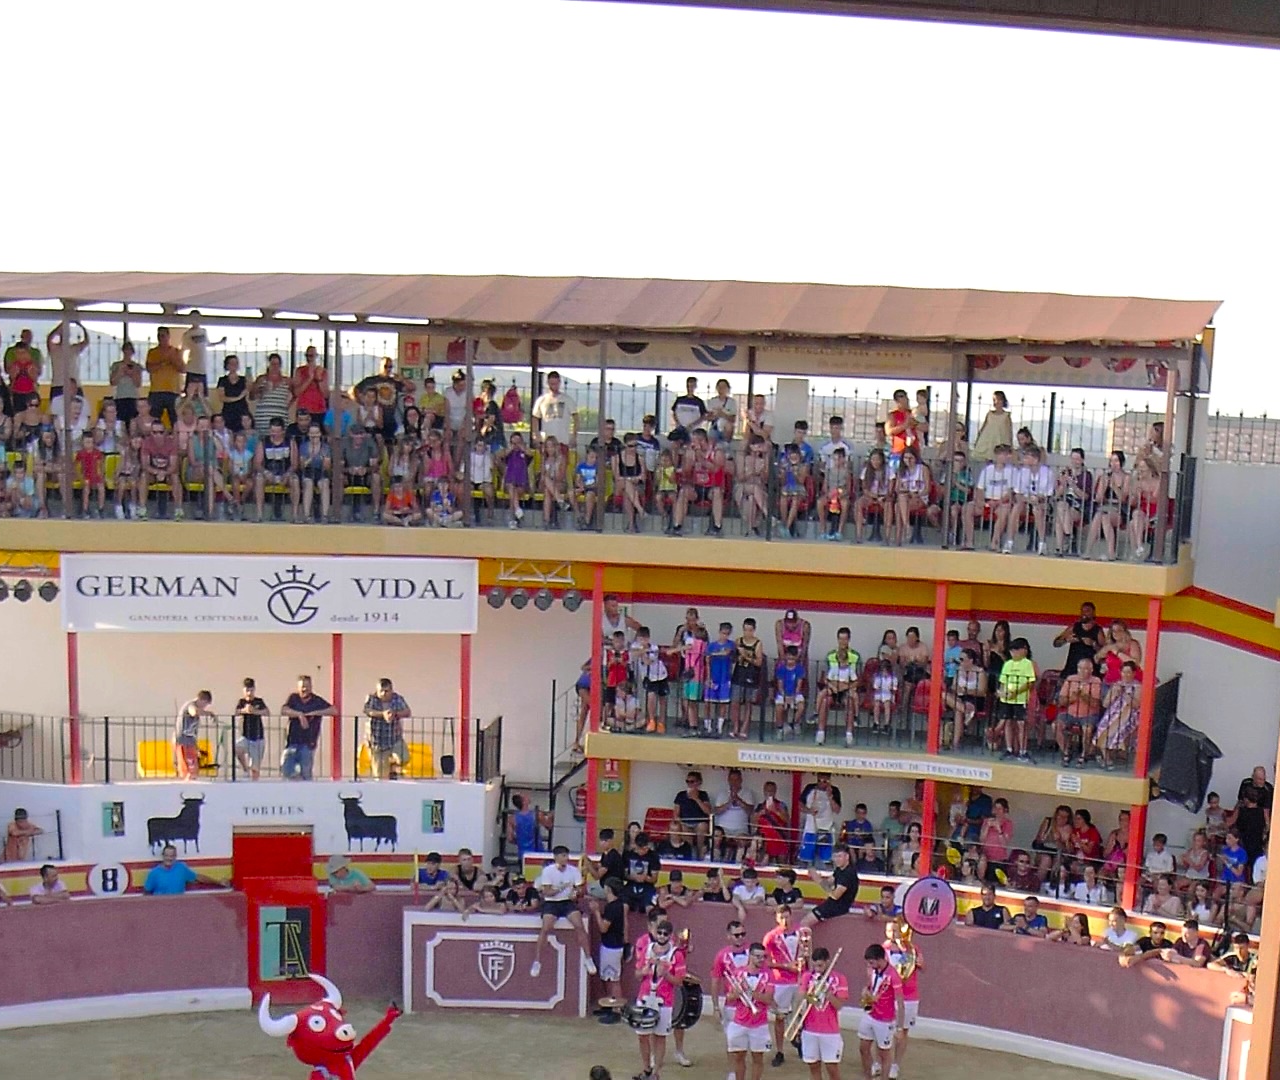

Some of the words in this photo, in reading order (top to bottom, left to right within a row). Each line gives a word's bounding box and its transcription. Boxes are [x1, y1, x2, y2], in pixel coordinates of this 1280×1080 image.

[76, 575, 240, 597] GERMAN
[350, 577, 464, 600] VIDAL
[330, 615, 360, 623] desde
[363, 612, 400, 623] 1914
[740, 751, 770, 762] PALCO
[102, 868, 118, 892] 8
